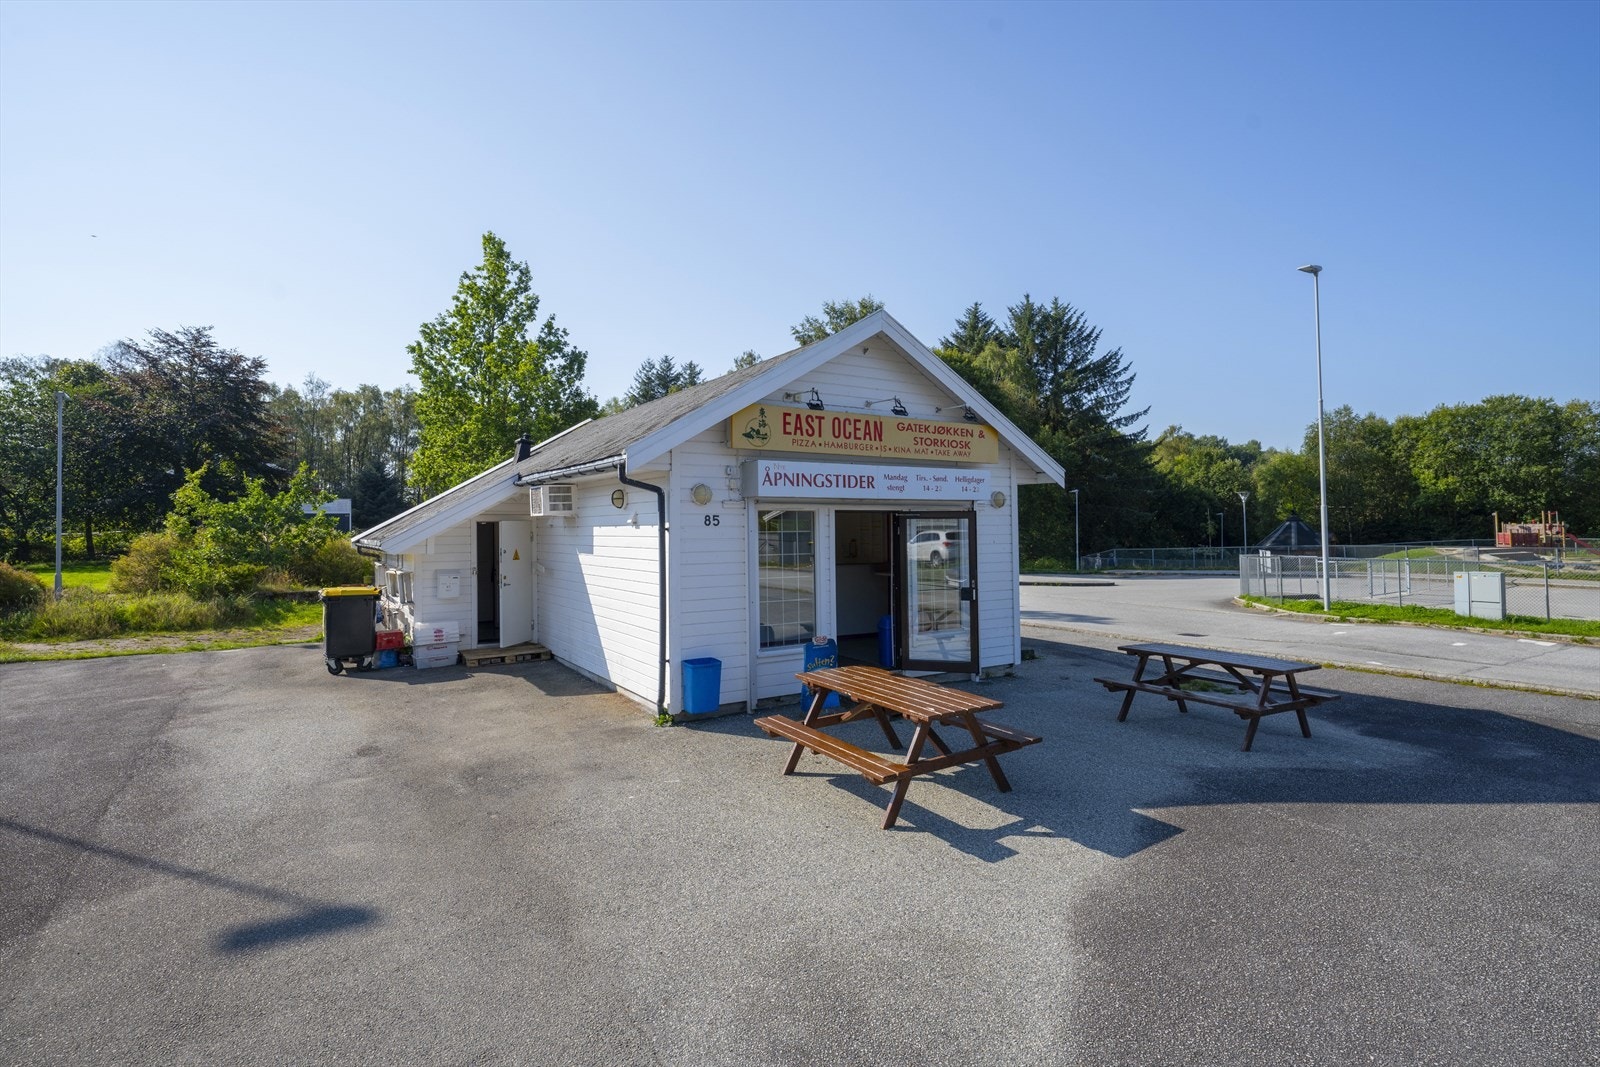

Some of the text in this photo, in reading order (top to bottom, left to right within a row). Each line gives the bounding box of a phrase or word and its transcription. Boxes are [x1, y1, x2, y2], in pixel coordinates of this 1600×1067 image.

[782, 412, 883, 442] EAST OCEAN
[896, 422, 986, 439] GATEKJØKKEN &
[791, 438, 817, 448] PIZZA
[823, 441, 874, 451] HAMBURGER
[893, 446, 912, 454] KINA
[914, 447, 929, 455] MAT
[935, 449, 951, 457] TAKE
[952, 450, 972, 458] AWAY
[913, 436, 971, 450] STORKIOSK
[762, 466, 876, 489] ÅPNINGSTIDER
[883, 474, 908, 482] Mandag
[916, 474, 928, 482] Tirs.
[954, 476, 985, 484] Helligdager
[886, 484, 905, 493] stengt
[703, 514, 720, 527] 85
